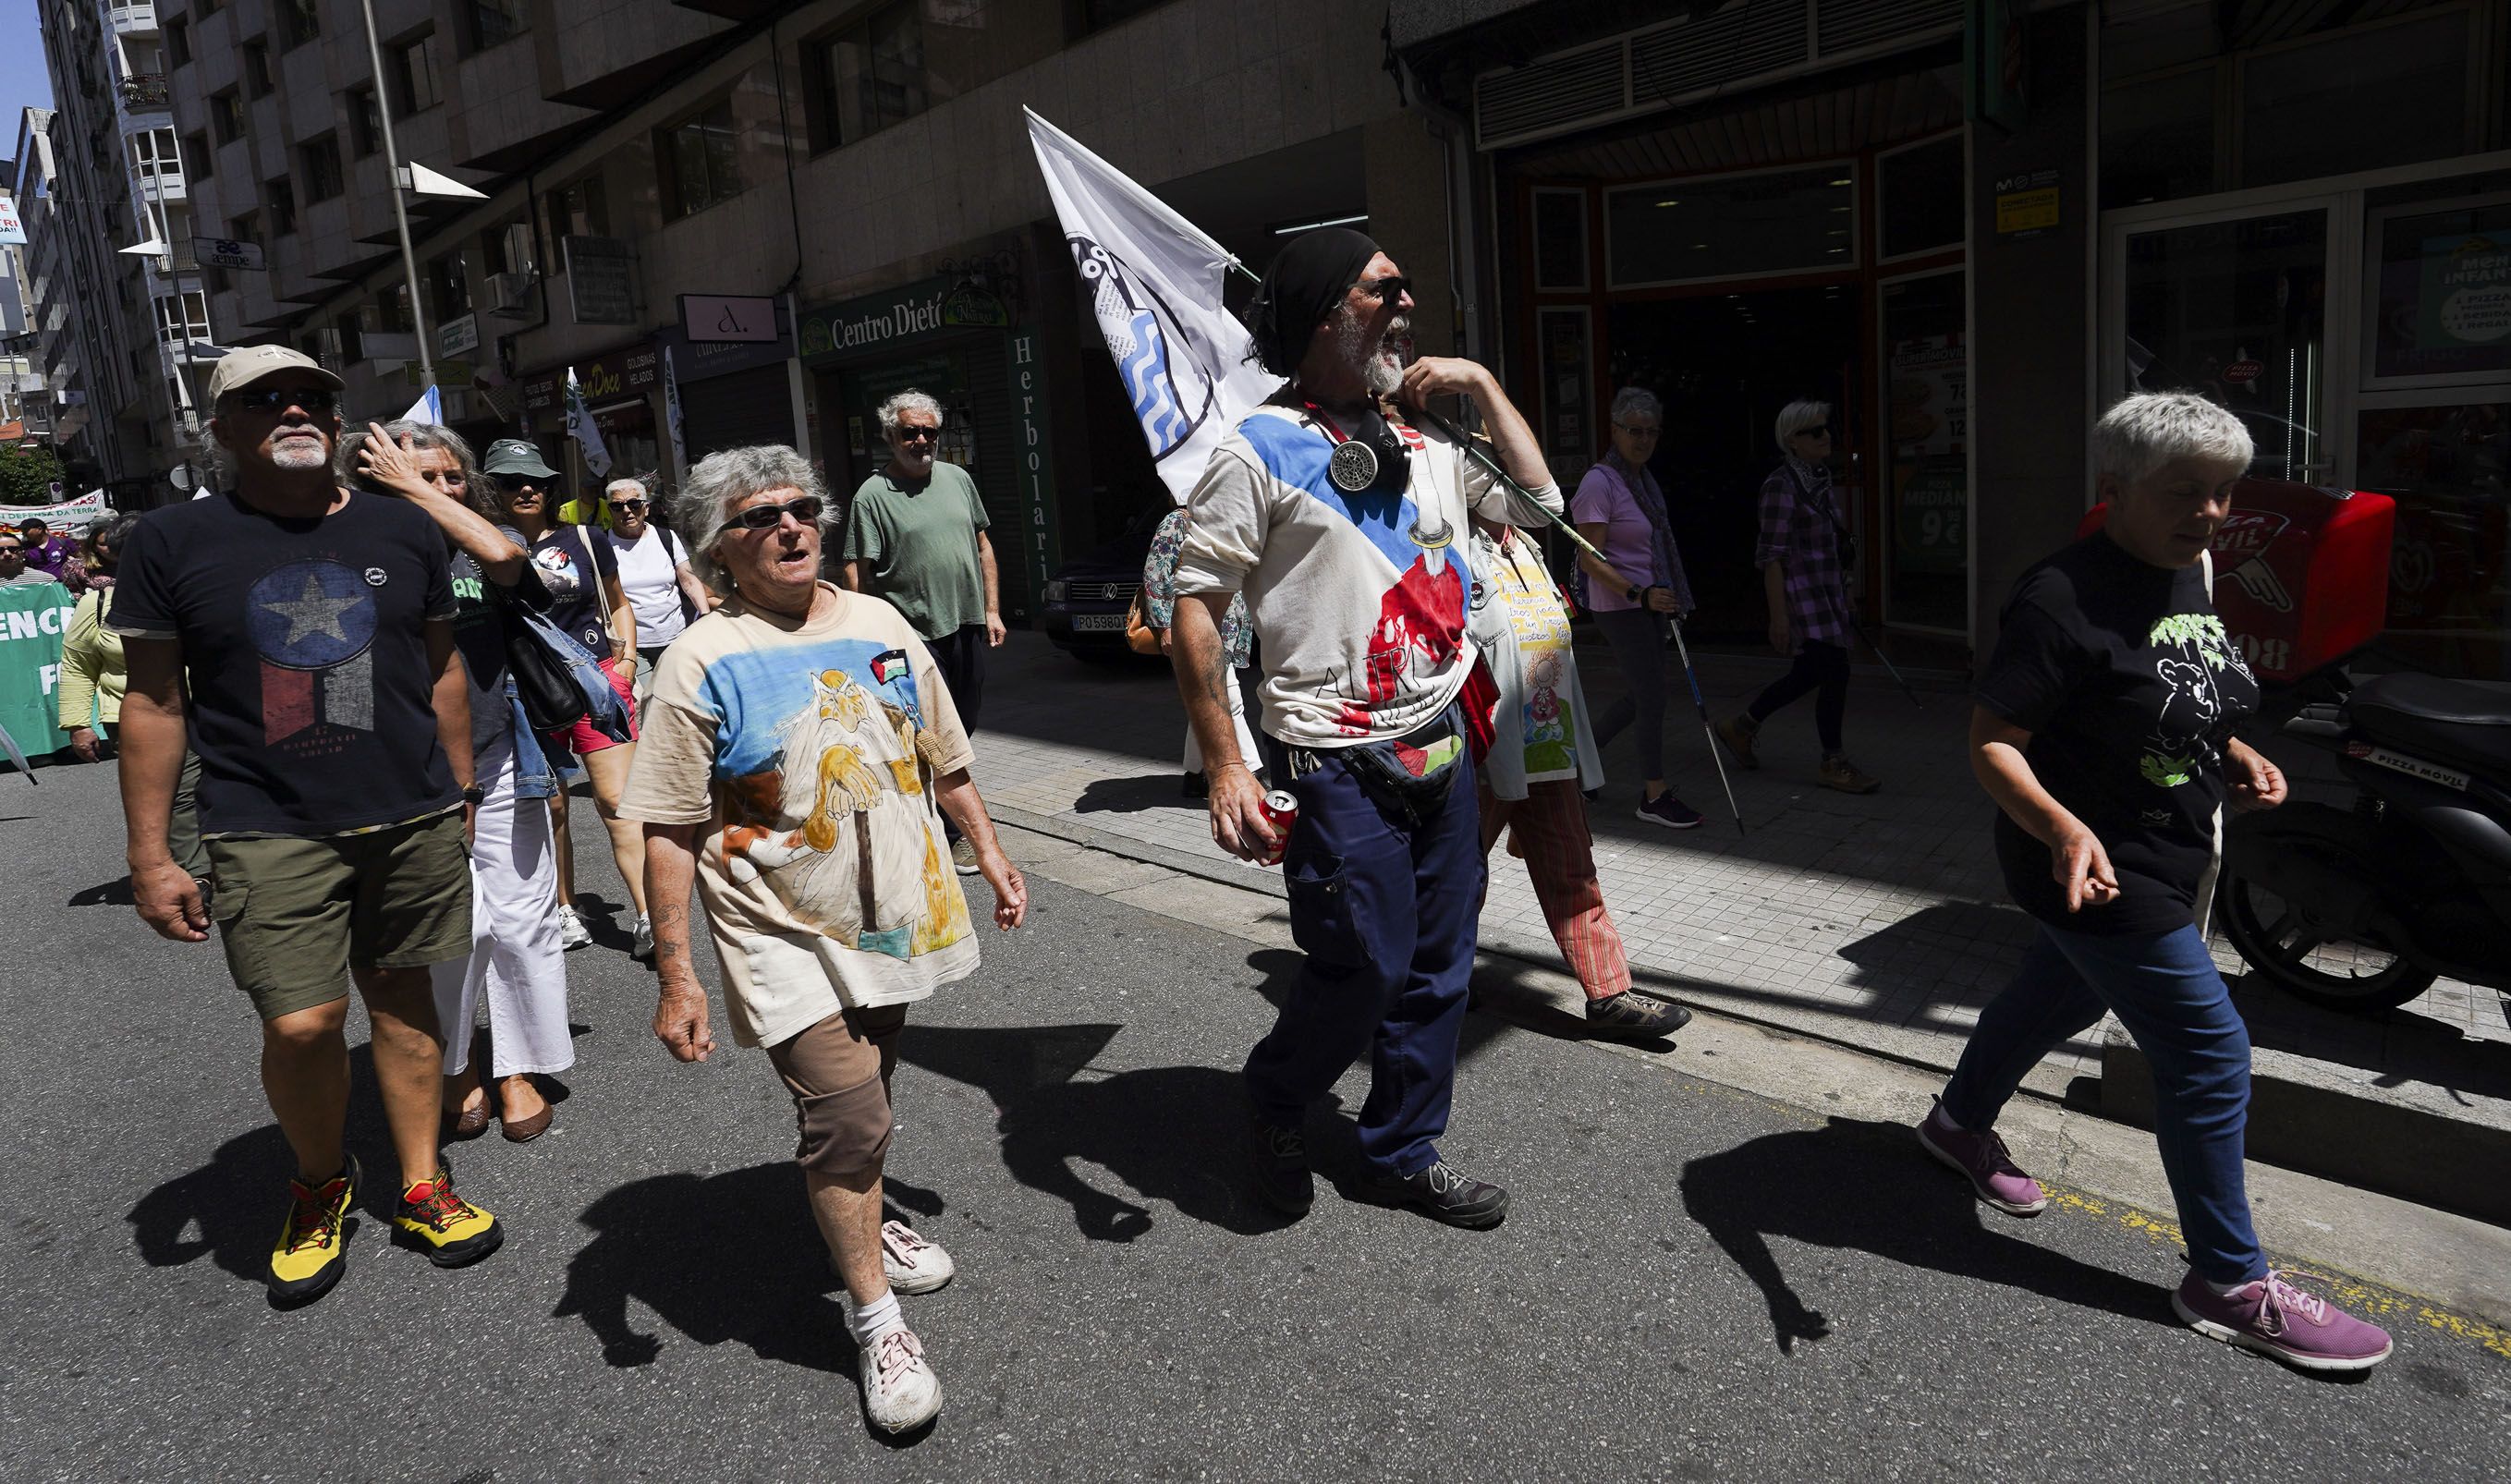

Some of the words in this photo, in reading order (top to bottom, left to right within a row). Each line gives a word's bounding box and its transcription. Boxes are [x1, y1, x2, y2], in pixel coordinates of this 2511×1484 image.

[832, 314, 892, 349] Centro
[629, 370, 654, 385] HELADOS
[8, 510, 54, 519] DEFENSA
[1093, 616, 1121, 628] 5980
[2378, 754, 2416, 772] PIZZA
